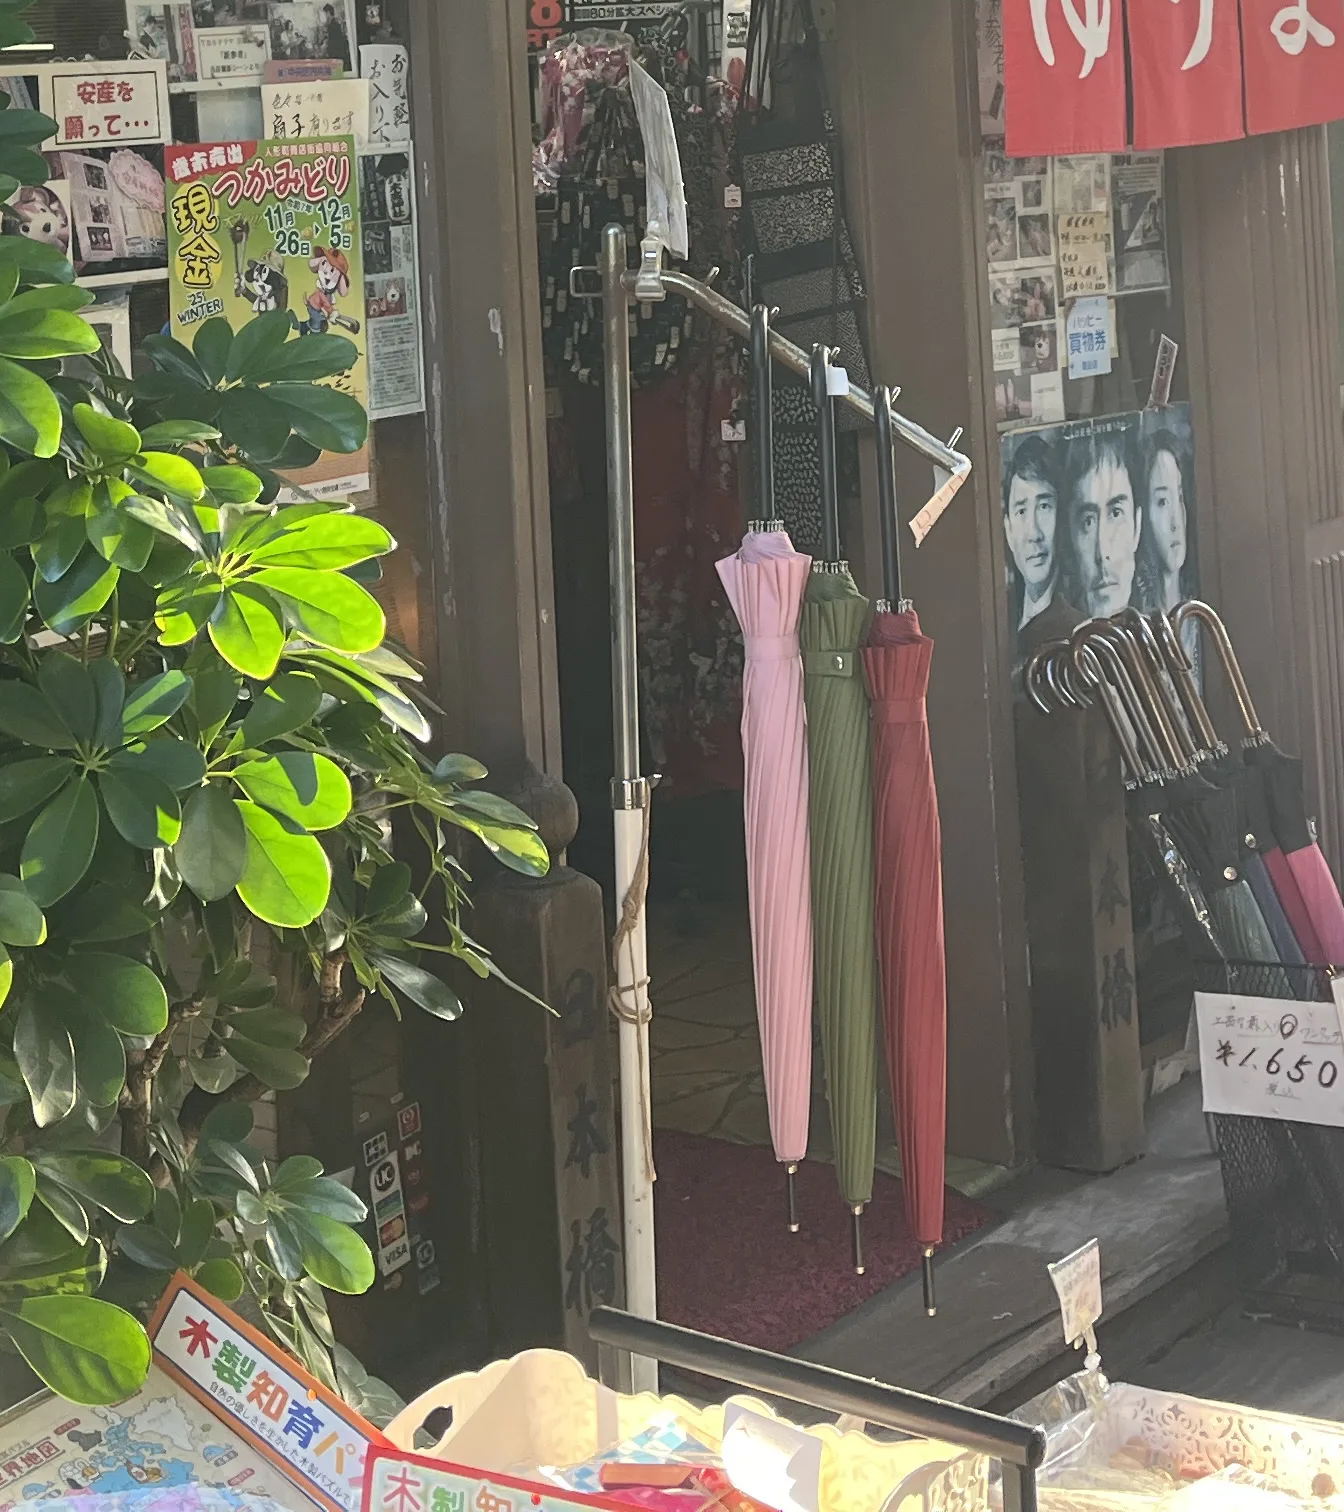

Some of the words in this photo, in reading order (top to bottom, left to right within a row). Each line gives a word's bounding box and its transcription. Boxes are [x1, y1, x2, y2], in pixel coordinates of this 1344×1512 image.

[76, 80, 134, 104] 安産を
[171, 143, 244, 182] 歳末売出
[212, 155, 350, 209] つかみどり
[171, 184, 221, 288] 現金
[274, 230, 312, 256] 26日
[329, 224, 352, 249] 5日
[1068, 330, 1107, 356] 買物券
[179, 1315, 369, 1488] 木製知育パ
